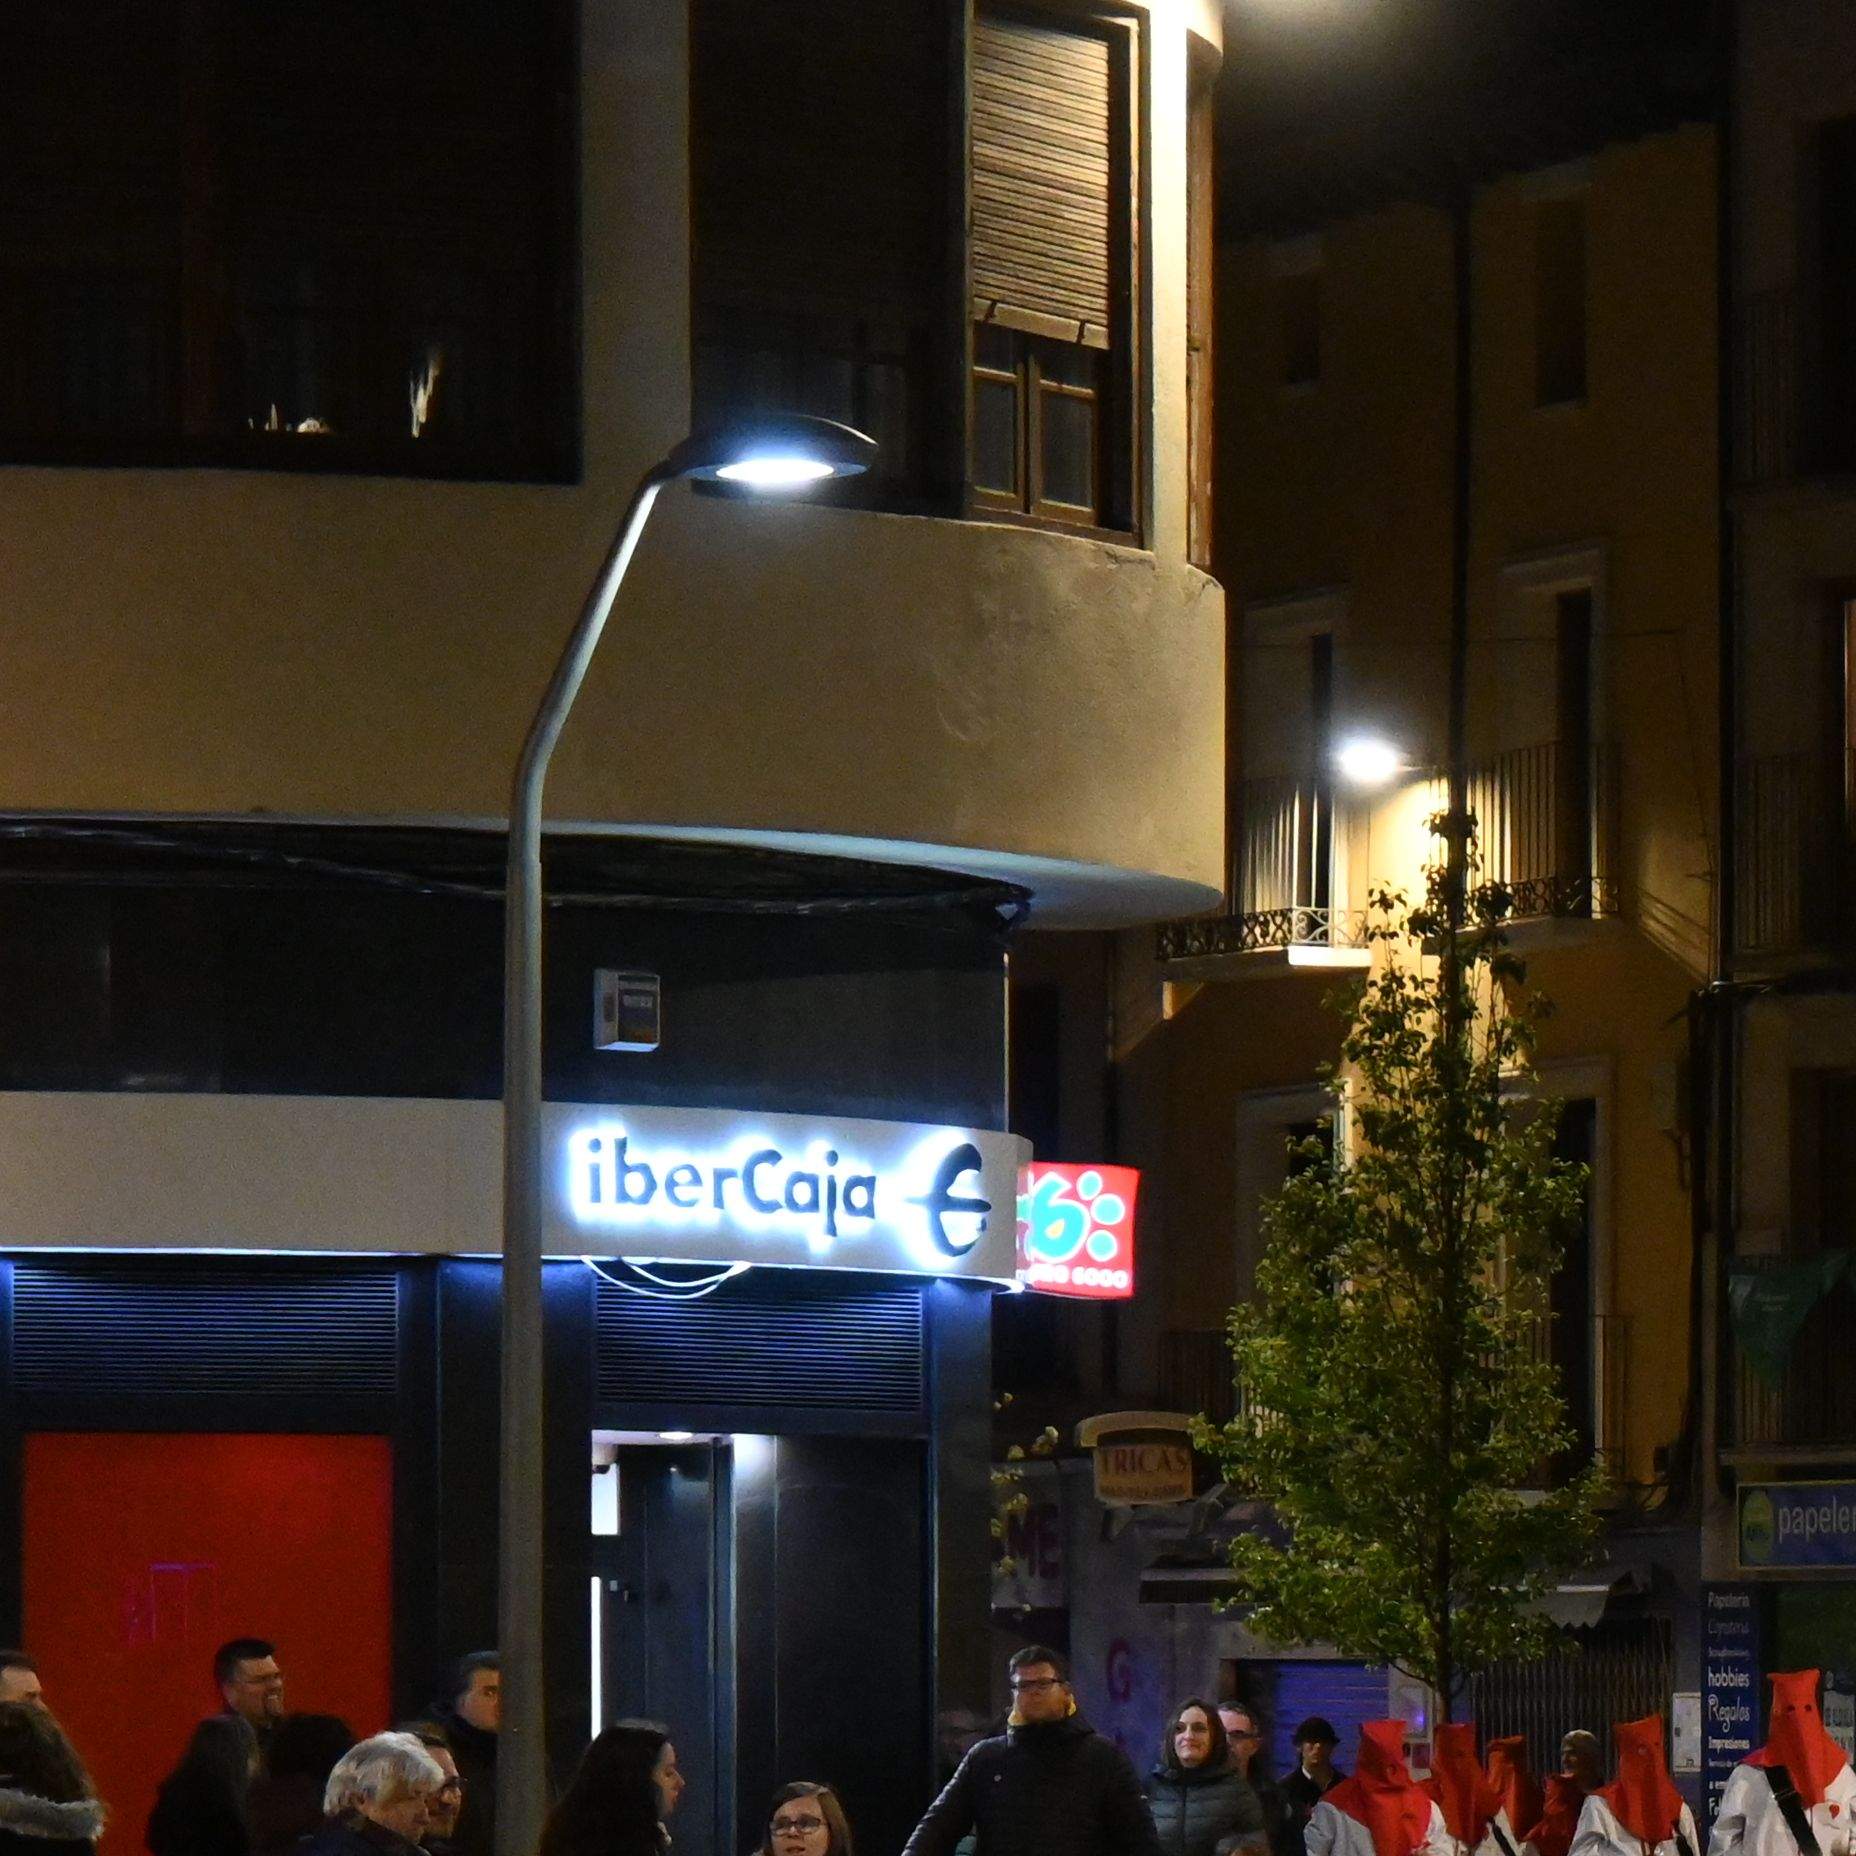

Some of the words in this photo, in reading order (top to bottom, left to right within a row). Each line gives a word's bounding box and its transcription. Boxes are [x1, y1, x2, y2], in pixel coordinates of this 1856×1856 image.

[588, 1135, 877, 1238] iberCaja
[1707, 1665, 1750, 1688] hobbies
[1707, 1693, 1750, 1733] Regalos
